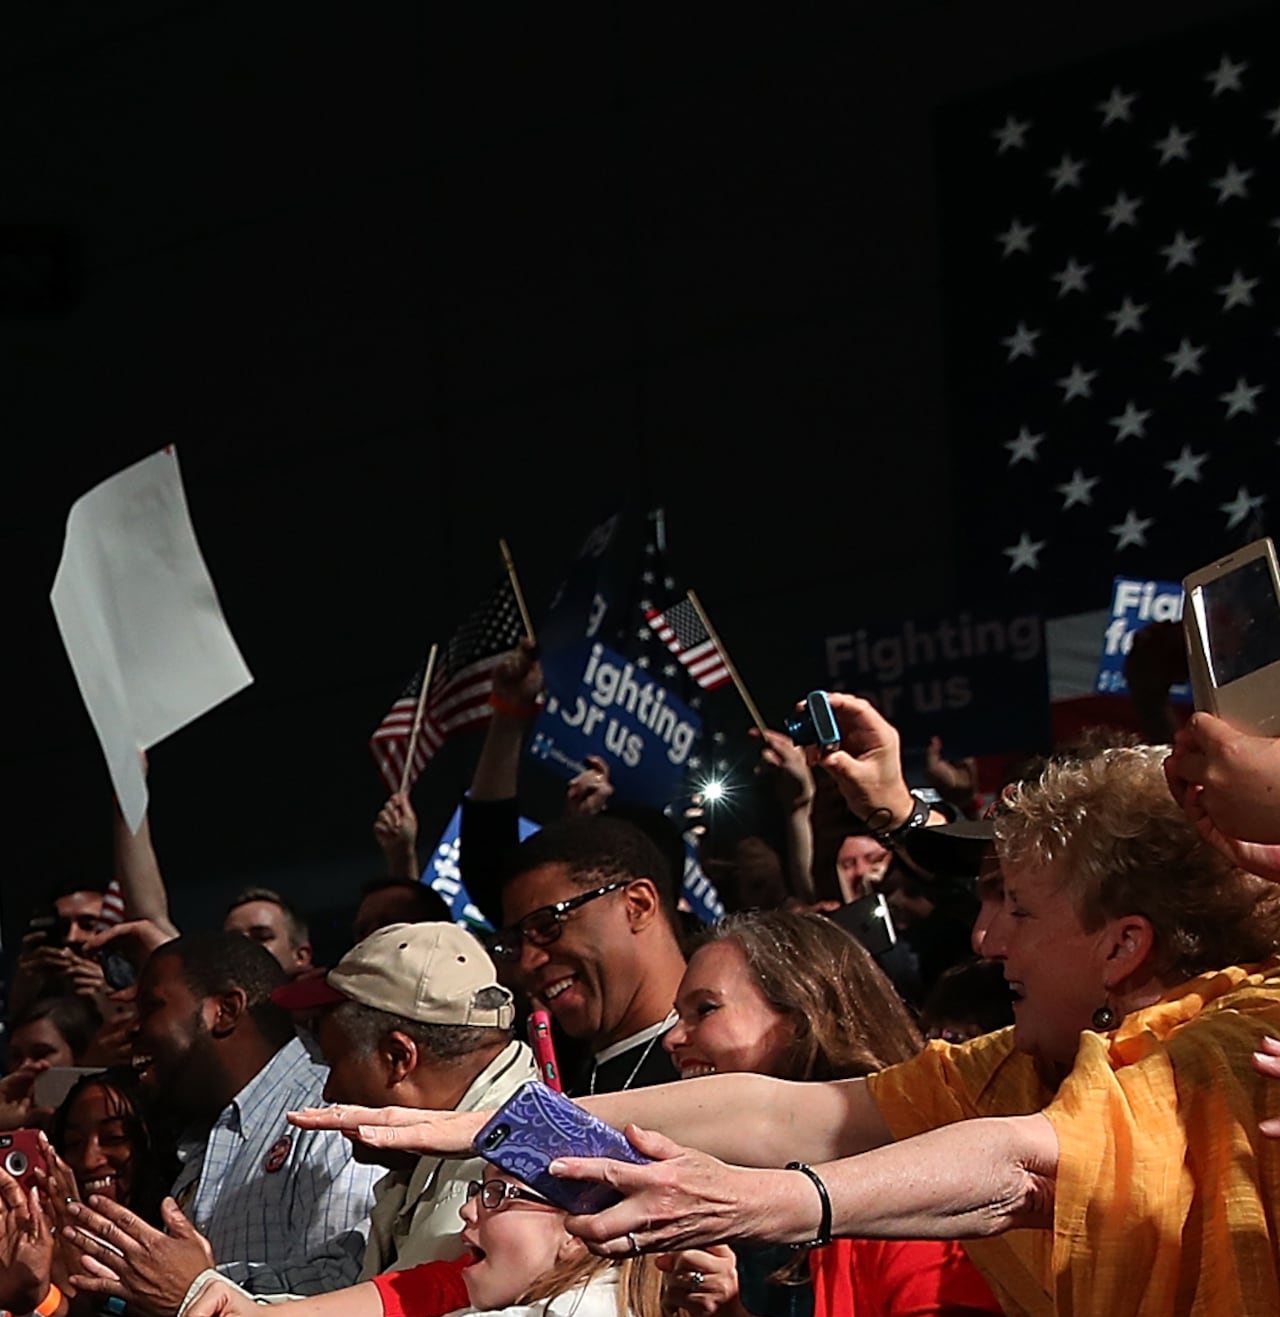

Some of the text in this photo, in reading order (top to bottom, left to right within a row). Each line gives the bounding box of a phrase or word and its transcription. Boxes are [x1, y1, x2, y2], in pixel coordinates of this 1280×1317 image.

[824, 611, 1041, 682] Fighting
[582, 641, 696, 765] ighting
[912, 675, 975, 714] us
[605, 718, 644, 768] us
